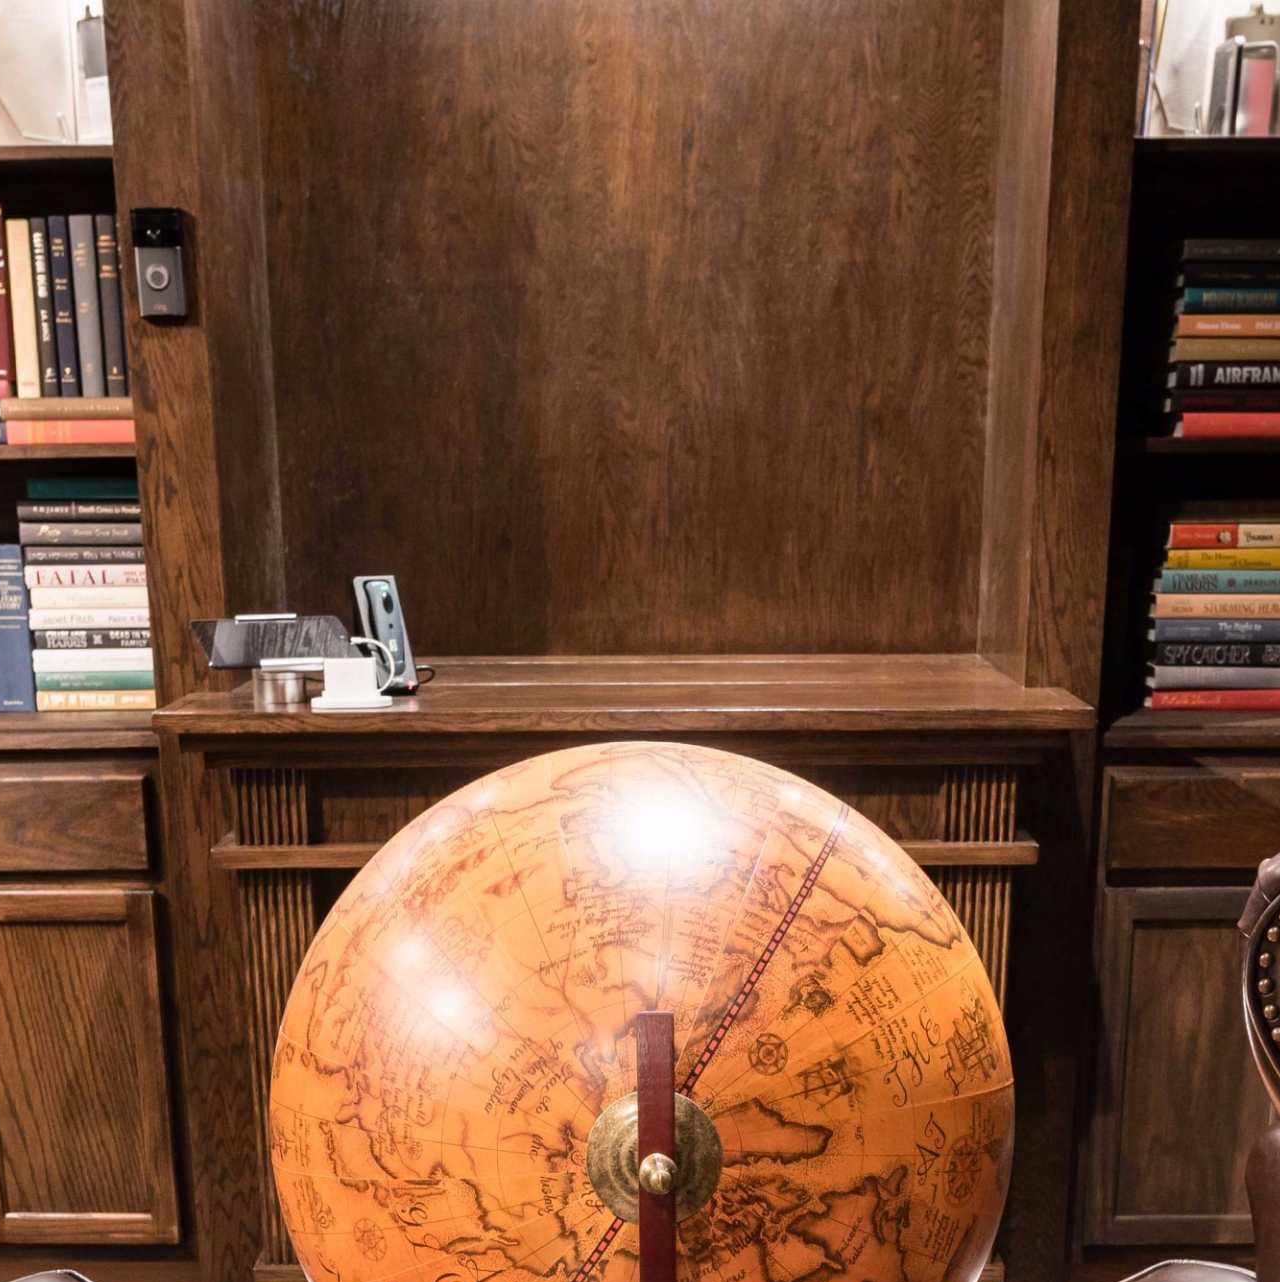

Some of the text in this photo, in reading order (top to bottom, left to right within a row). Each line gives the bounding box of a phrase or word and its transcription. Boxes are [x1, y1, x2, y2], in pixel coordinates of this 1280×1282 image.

[36, 570, 114, 585] FATAL
[1172, 580, 1218, 592] HARRIS
[1204, 603, 1256, 615] STORMING
[1218, 622, 1232, 631] The
[109, 630, 129, 640] DEAD
[46, 638, 87, 648] HARRIS
[507, 1081, 536, 1116] human
